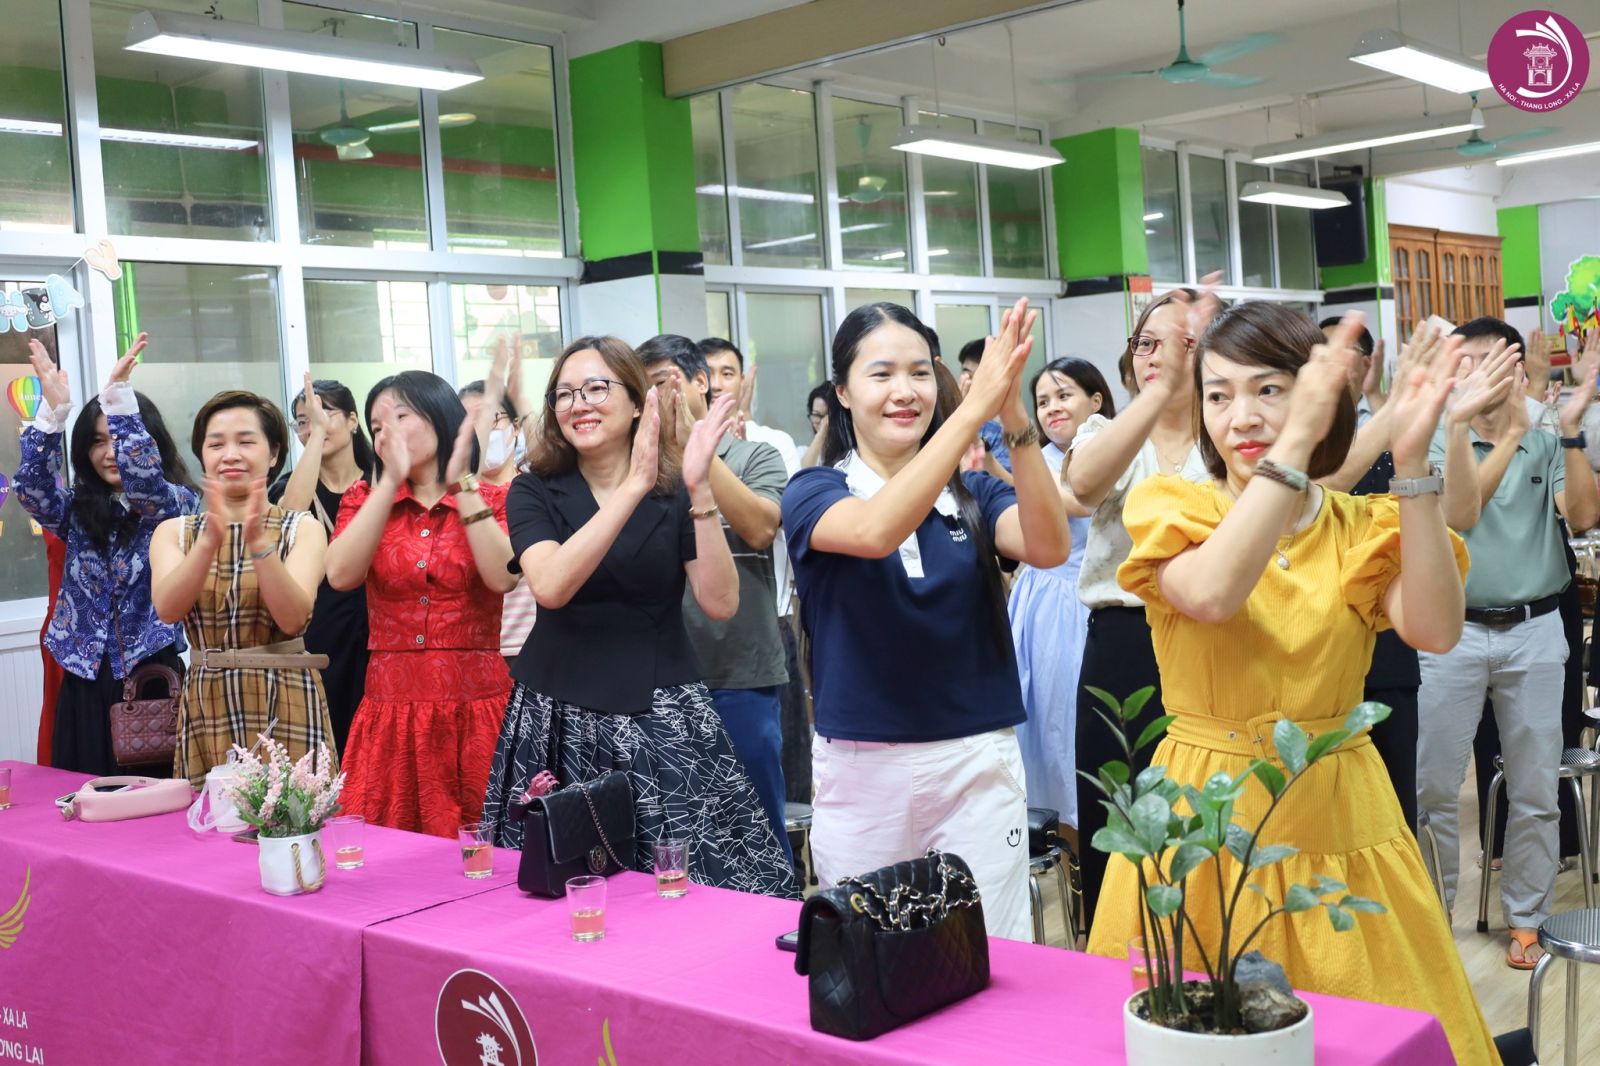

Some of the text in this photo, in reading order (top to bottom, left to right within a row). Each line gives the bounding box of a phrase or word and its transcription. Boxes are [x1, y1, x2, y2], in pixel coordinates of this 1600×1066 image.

[3, 1006, 28, 1030] XA LA
[25, 1044, 44, 1066] LAI
